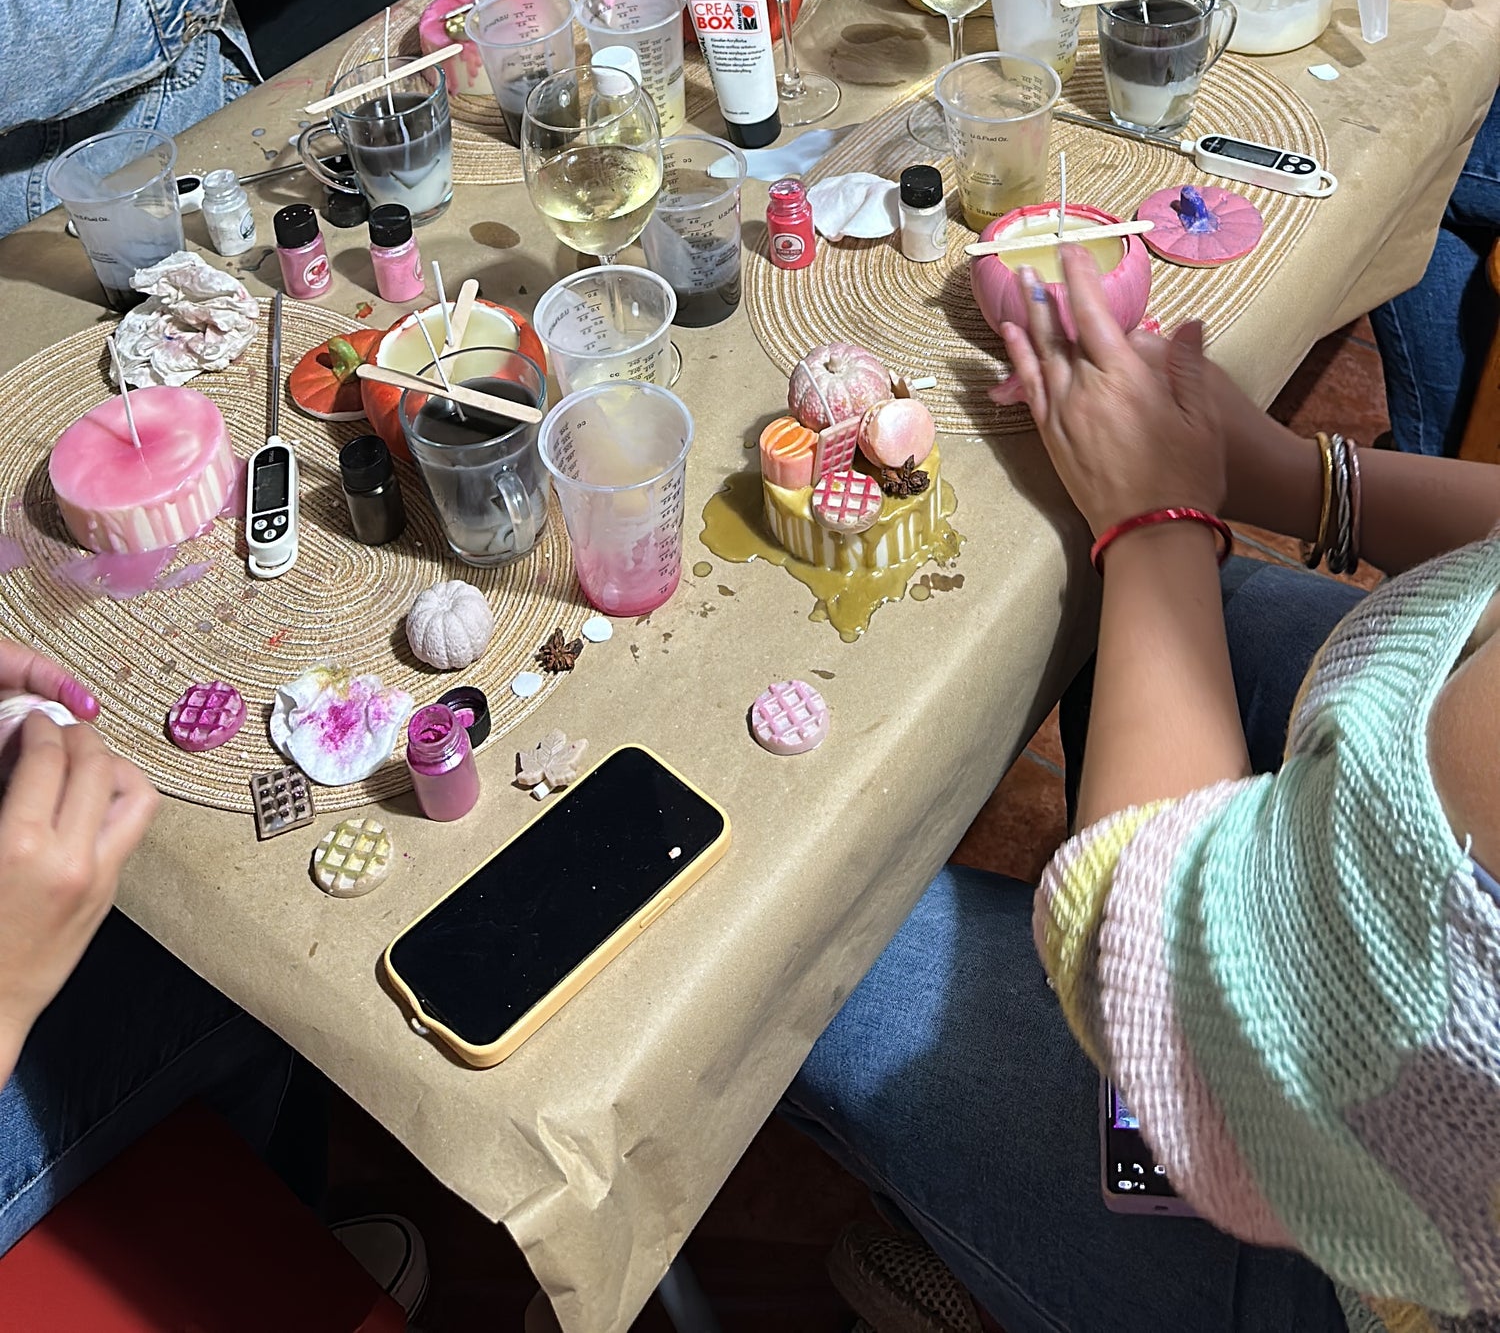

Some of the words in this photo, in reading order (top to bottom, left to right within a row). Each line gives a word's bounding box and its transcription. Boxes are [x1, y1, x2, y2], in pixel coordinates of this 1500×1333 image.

[694, 2, 734, 16] CREA
[696, 16, 735, 30] BOX
[735, 3, 743, 30] Marabu
